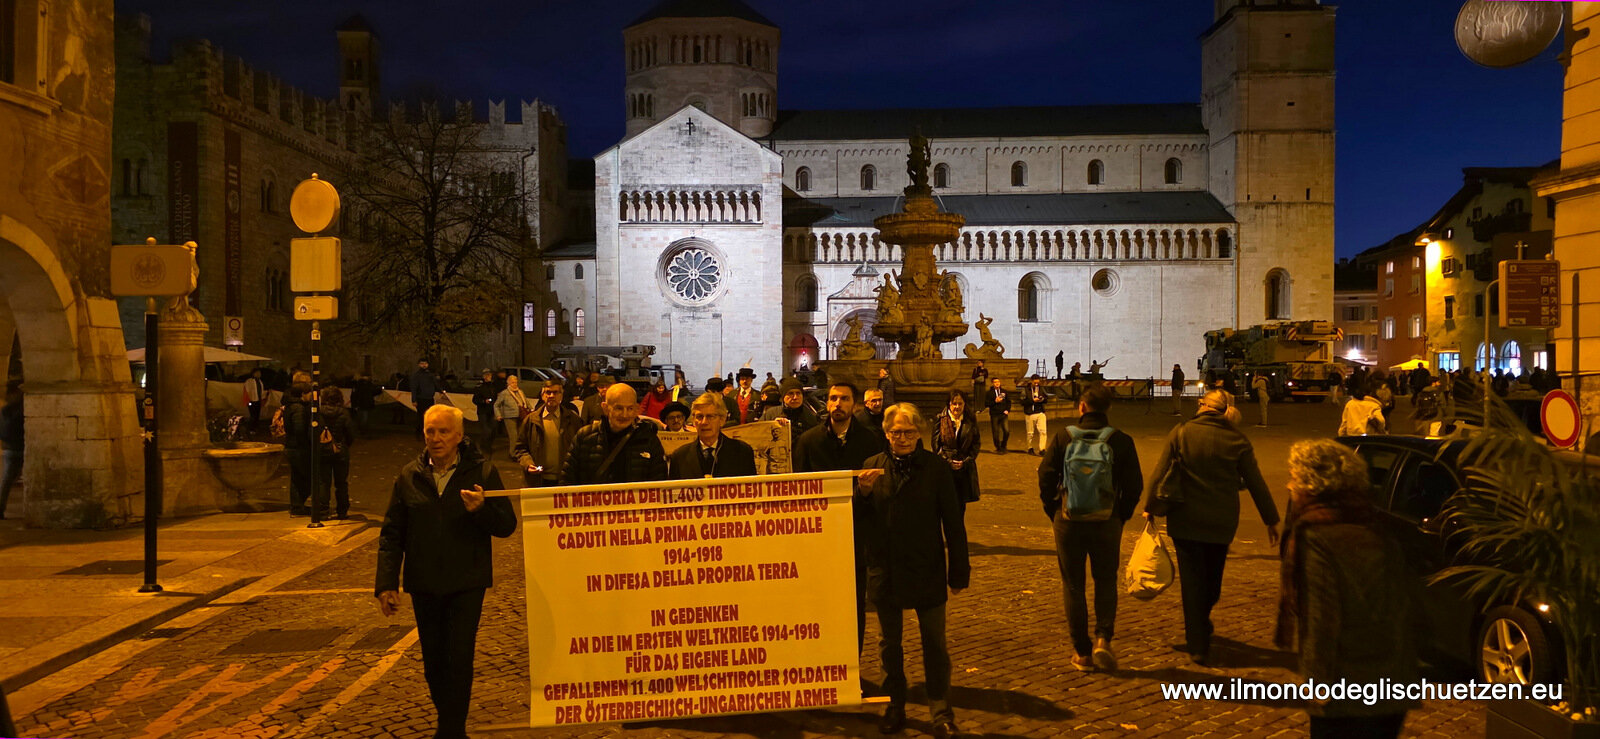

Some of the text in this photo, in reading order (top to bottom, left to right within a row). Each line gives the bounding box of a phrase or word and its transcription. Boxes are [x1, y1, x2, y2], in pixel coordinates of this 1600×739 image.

[554, 479, 824, 508] IN MEMORIA DEI 11.400 TIROLESI TRENTINI
[548, 512, 604, 529] SOLDATI
[707, 498, 829, 518] AUSTRO-UNGARICO
[557, 516, 823, 549] CADUTI NELLA PRIMA GUERRA MONDIALE
[663, 546, 723, 565] 1914-1918
[587, 561, 799, 592] IN DIFESA DELLA PROPRIA TERRA
[651, 604, 739, 627] IN GEDENKEN
[569, 622, 820, 655] AN DIE IM ERSTEN WELTKRIEG 1914-1918
[625, 647, 767, 674] FÜR DAS EIGENE LAND
[543, 665, 848, 701] GEFALLENEN 11.400 WELSCHTIROLER SOLDATEN
[555, 687, 838, 724] DER ÖSTERREICHISCH-UNGARISCHEN ARMEE
